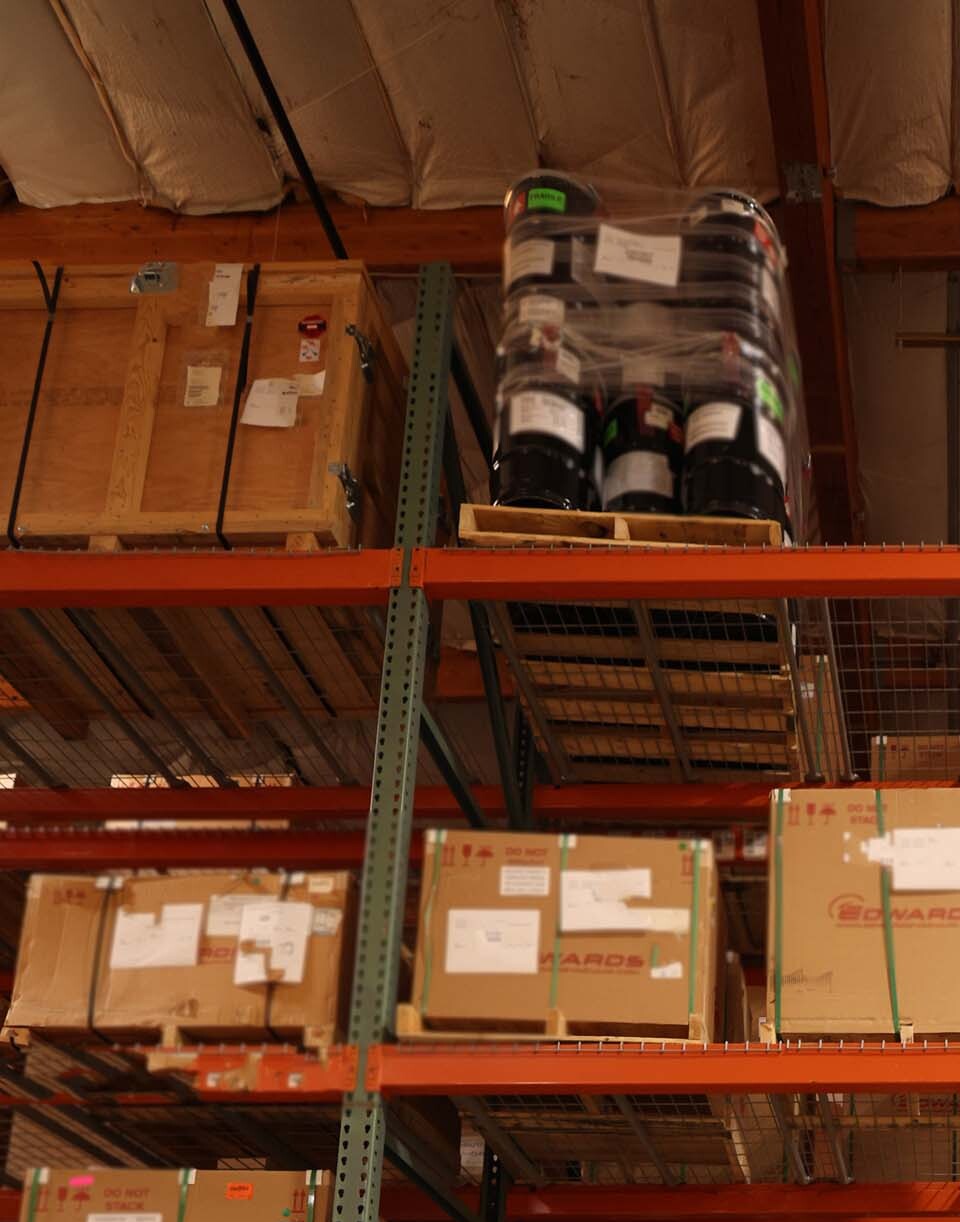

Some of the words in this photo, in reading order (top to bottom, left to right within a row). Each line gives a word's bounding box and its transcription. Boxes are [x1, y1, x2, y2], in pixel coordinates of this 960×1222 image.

[539, 952, 645, 968] WARDS
[104, 1187, 122, 1198] DO
[125, 1187, 150, 1198] NOT
